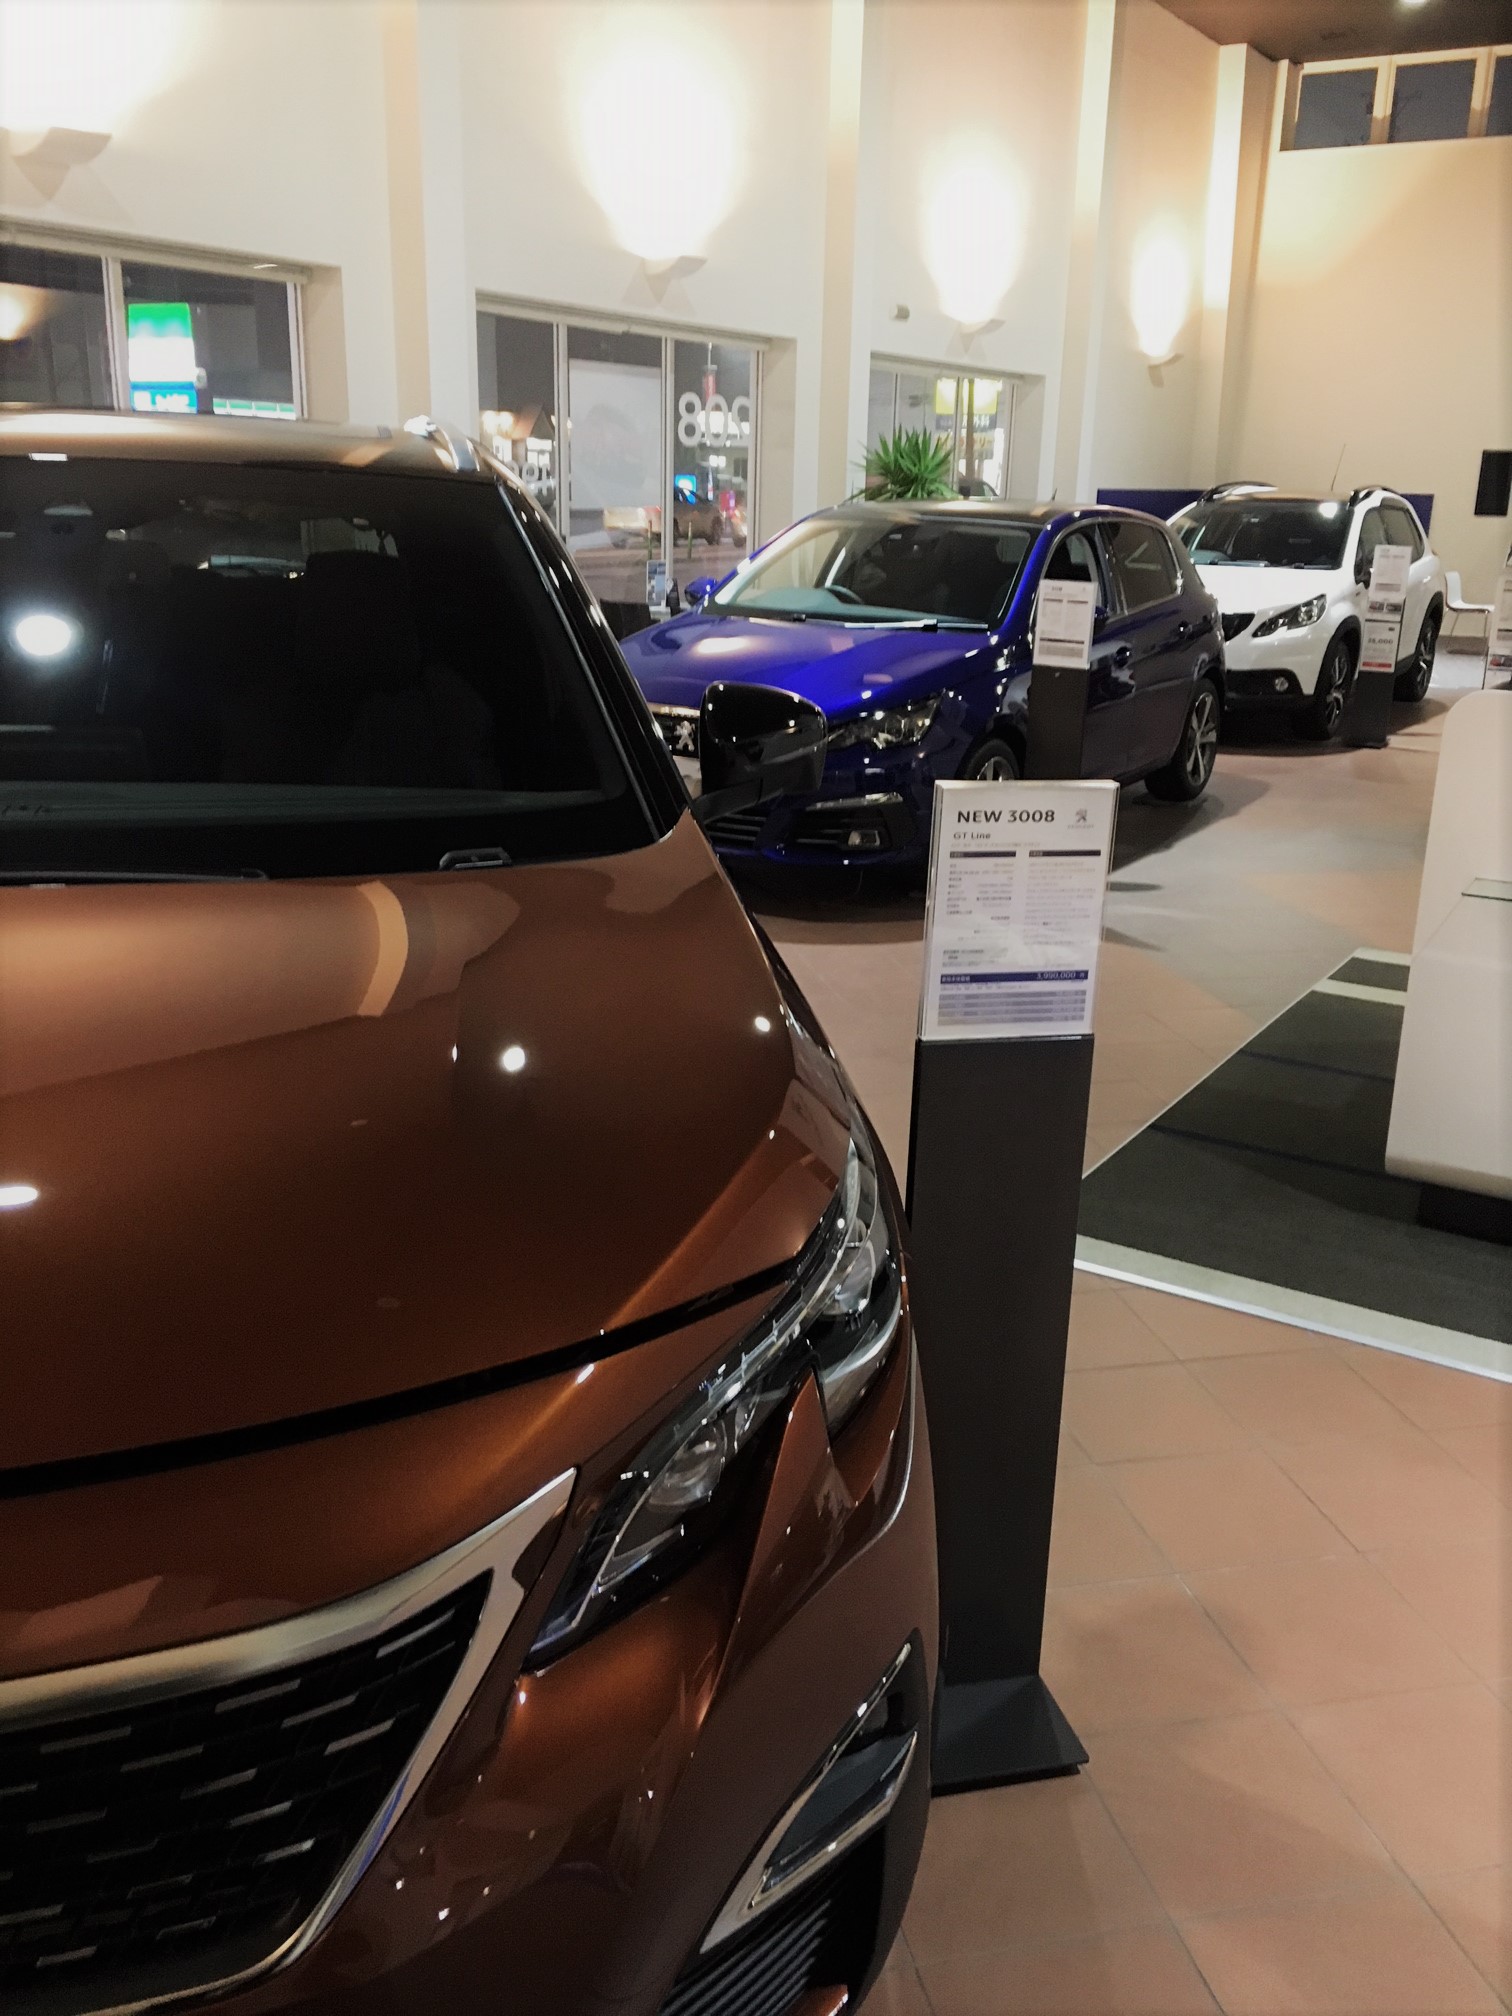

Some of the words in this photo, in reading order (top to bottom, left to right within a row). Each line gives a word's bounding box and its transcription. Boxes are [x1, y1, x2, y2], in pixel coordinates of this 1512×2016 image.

[957, 809, 1002, 824] NEW
[1008, 809, 1056, 823] 3008
[953, 831, 967, 840] GT
[971, 831, 991, 840] Line
